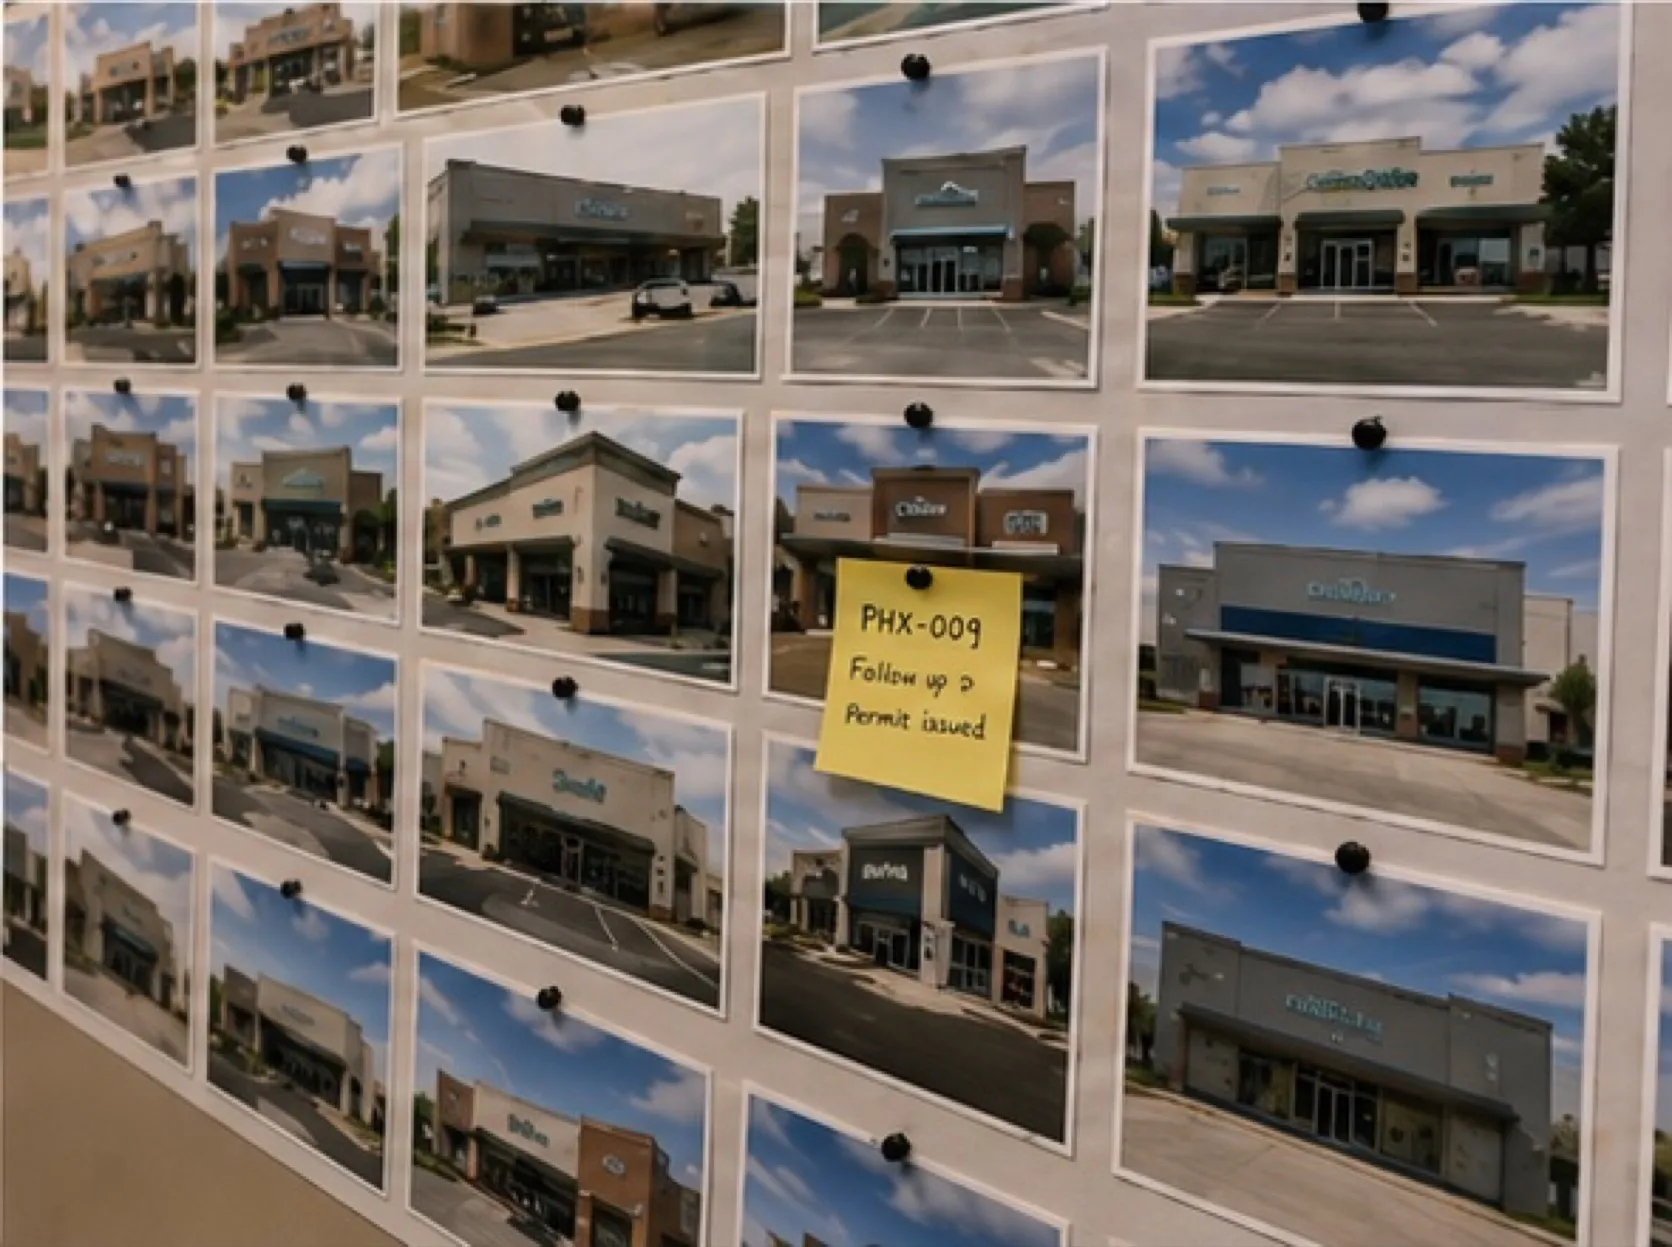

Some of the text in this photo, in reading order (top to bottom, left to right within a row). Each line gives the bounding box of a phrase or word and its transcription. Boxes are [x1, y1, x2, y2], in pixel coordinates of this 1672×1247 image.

[861, 603, 982, 650] PHX-009
[850, 655, 916, 687] Follow
[926, 674, 947, 698] up
[844, 702, 910, 731] Permit
